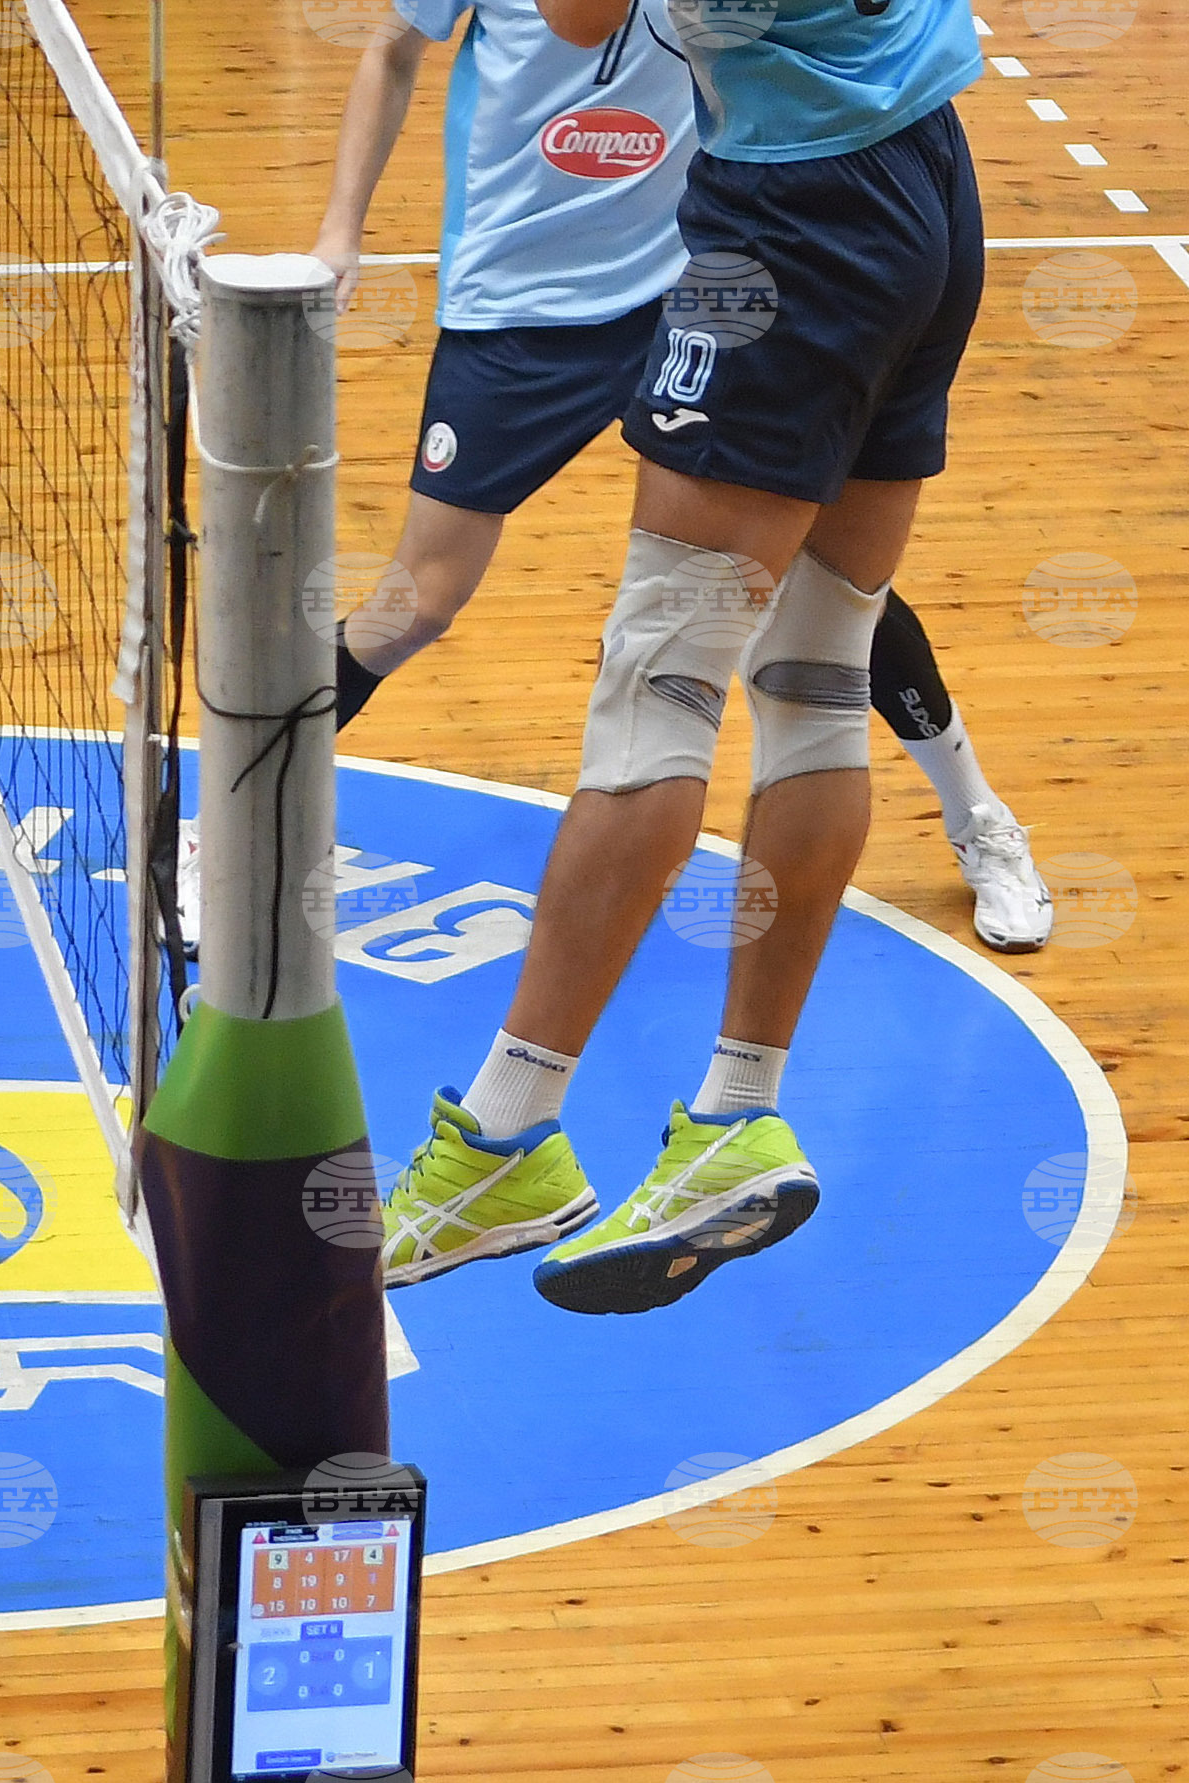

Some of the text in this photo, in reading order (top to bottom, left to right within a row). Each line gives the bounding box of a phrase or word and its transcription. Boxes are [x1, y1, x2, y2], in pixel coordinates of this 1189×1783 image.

[546, 118, 661, 166] Compass
[653, 327, 717, 403] 10
[301, 1575, 318, 1587] 19
[306, 1624, 326, 1636] SET
[261, 1661, 375, 1686] 2 1
